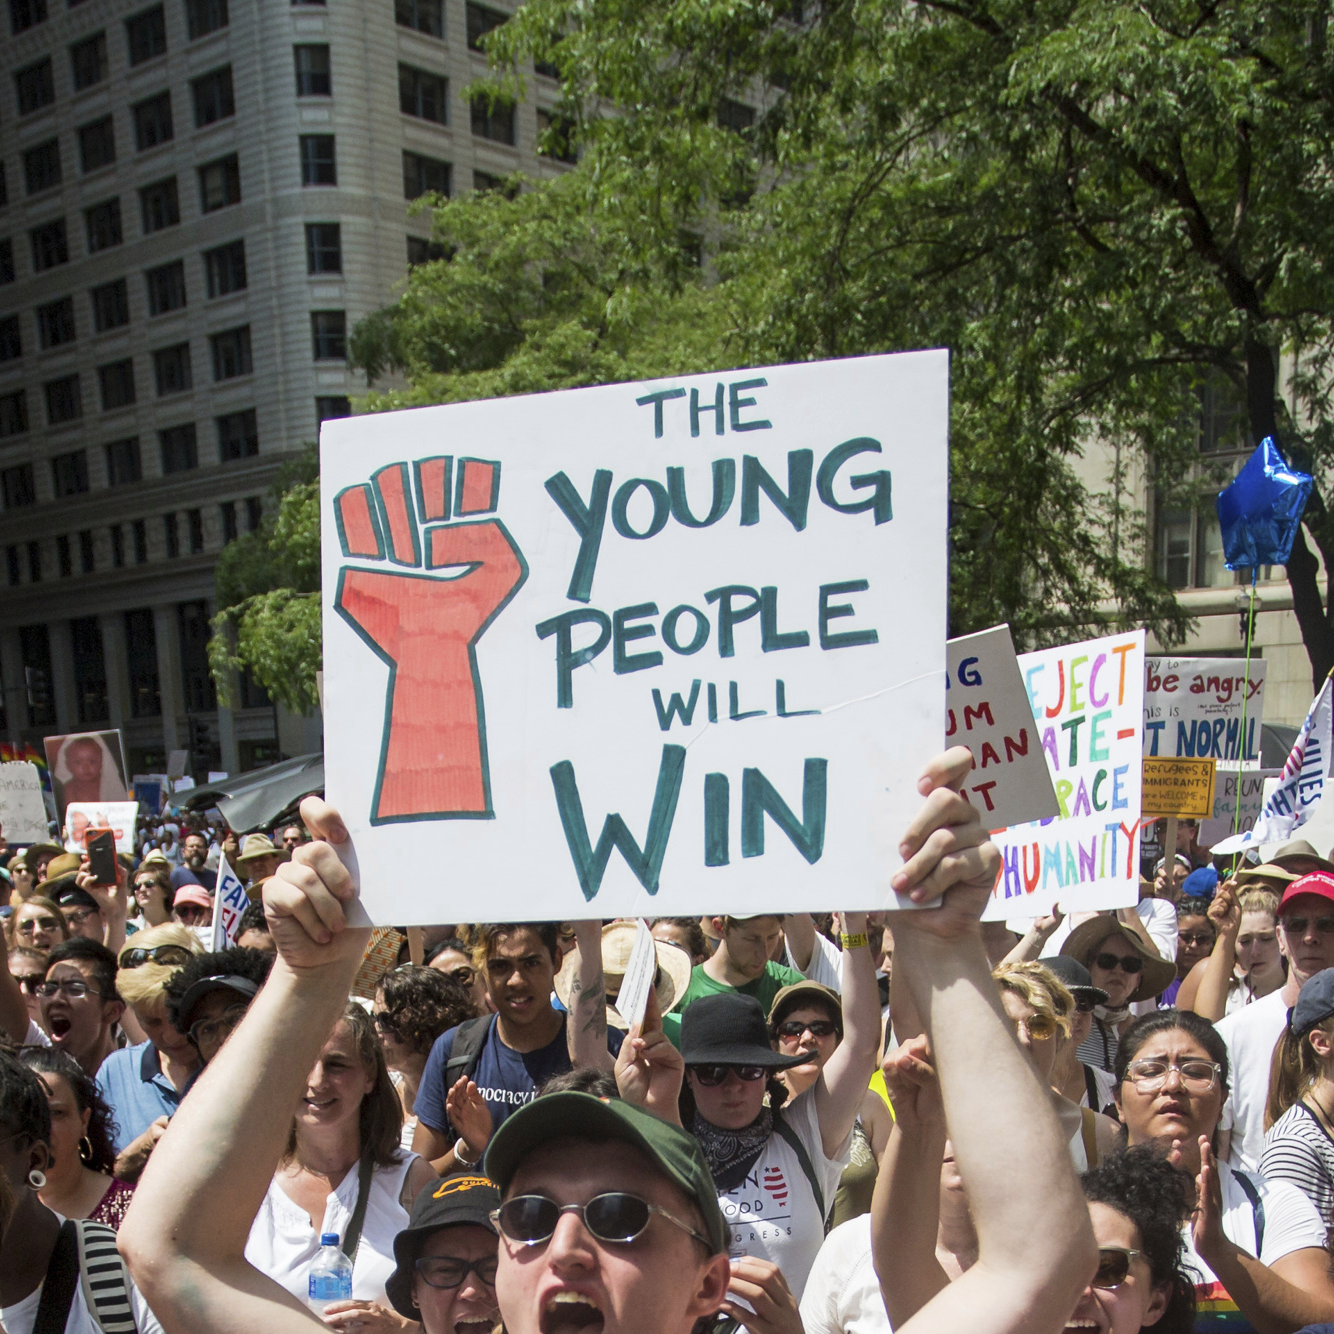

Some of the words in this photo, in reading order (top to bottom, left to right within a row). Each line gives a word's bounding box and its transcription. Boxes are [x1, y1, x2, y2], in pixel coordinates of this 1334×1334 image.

[636, 377, 773, 438] THE
[544, 436, 894, 602] YOUNG
[535, 578, 880, 709] PEOPLE
[1167, 659, 1179, 669] to
[946, 656, 983, 691] G
[1026, 642, 1137, 720] EJECT
[1146, 666, 1180, 693] be
[1189, 673, 1264, 703] angry.
[651, 678, 822, 731] WILL
[1169, 705, 1180, 717] is
[1143, 720, 1165, 757] T
[1176, 717, 1259, 761] NORMAL
[1144, 763, 1199, 778] Refugees
[1202, 764, 1209, 776] &
[1224, 777, 1264, 797] REUN
[1159, 790, 1198, 800] WELCOME
[549, 743, 829, 902] WIN
[1003, 817, 1141, 900] HUMANITY
